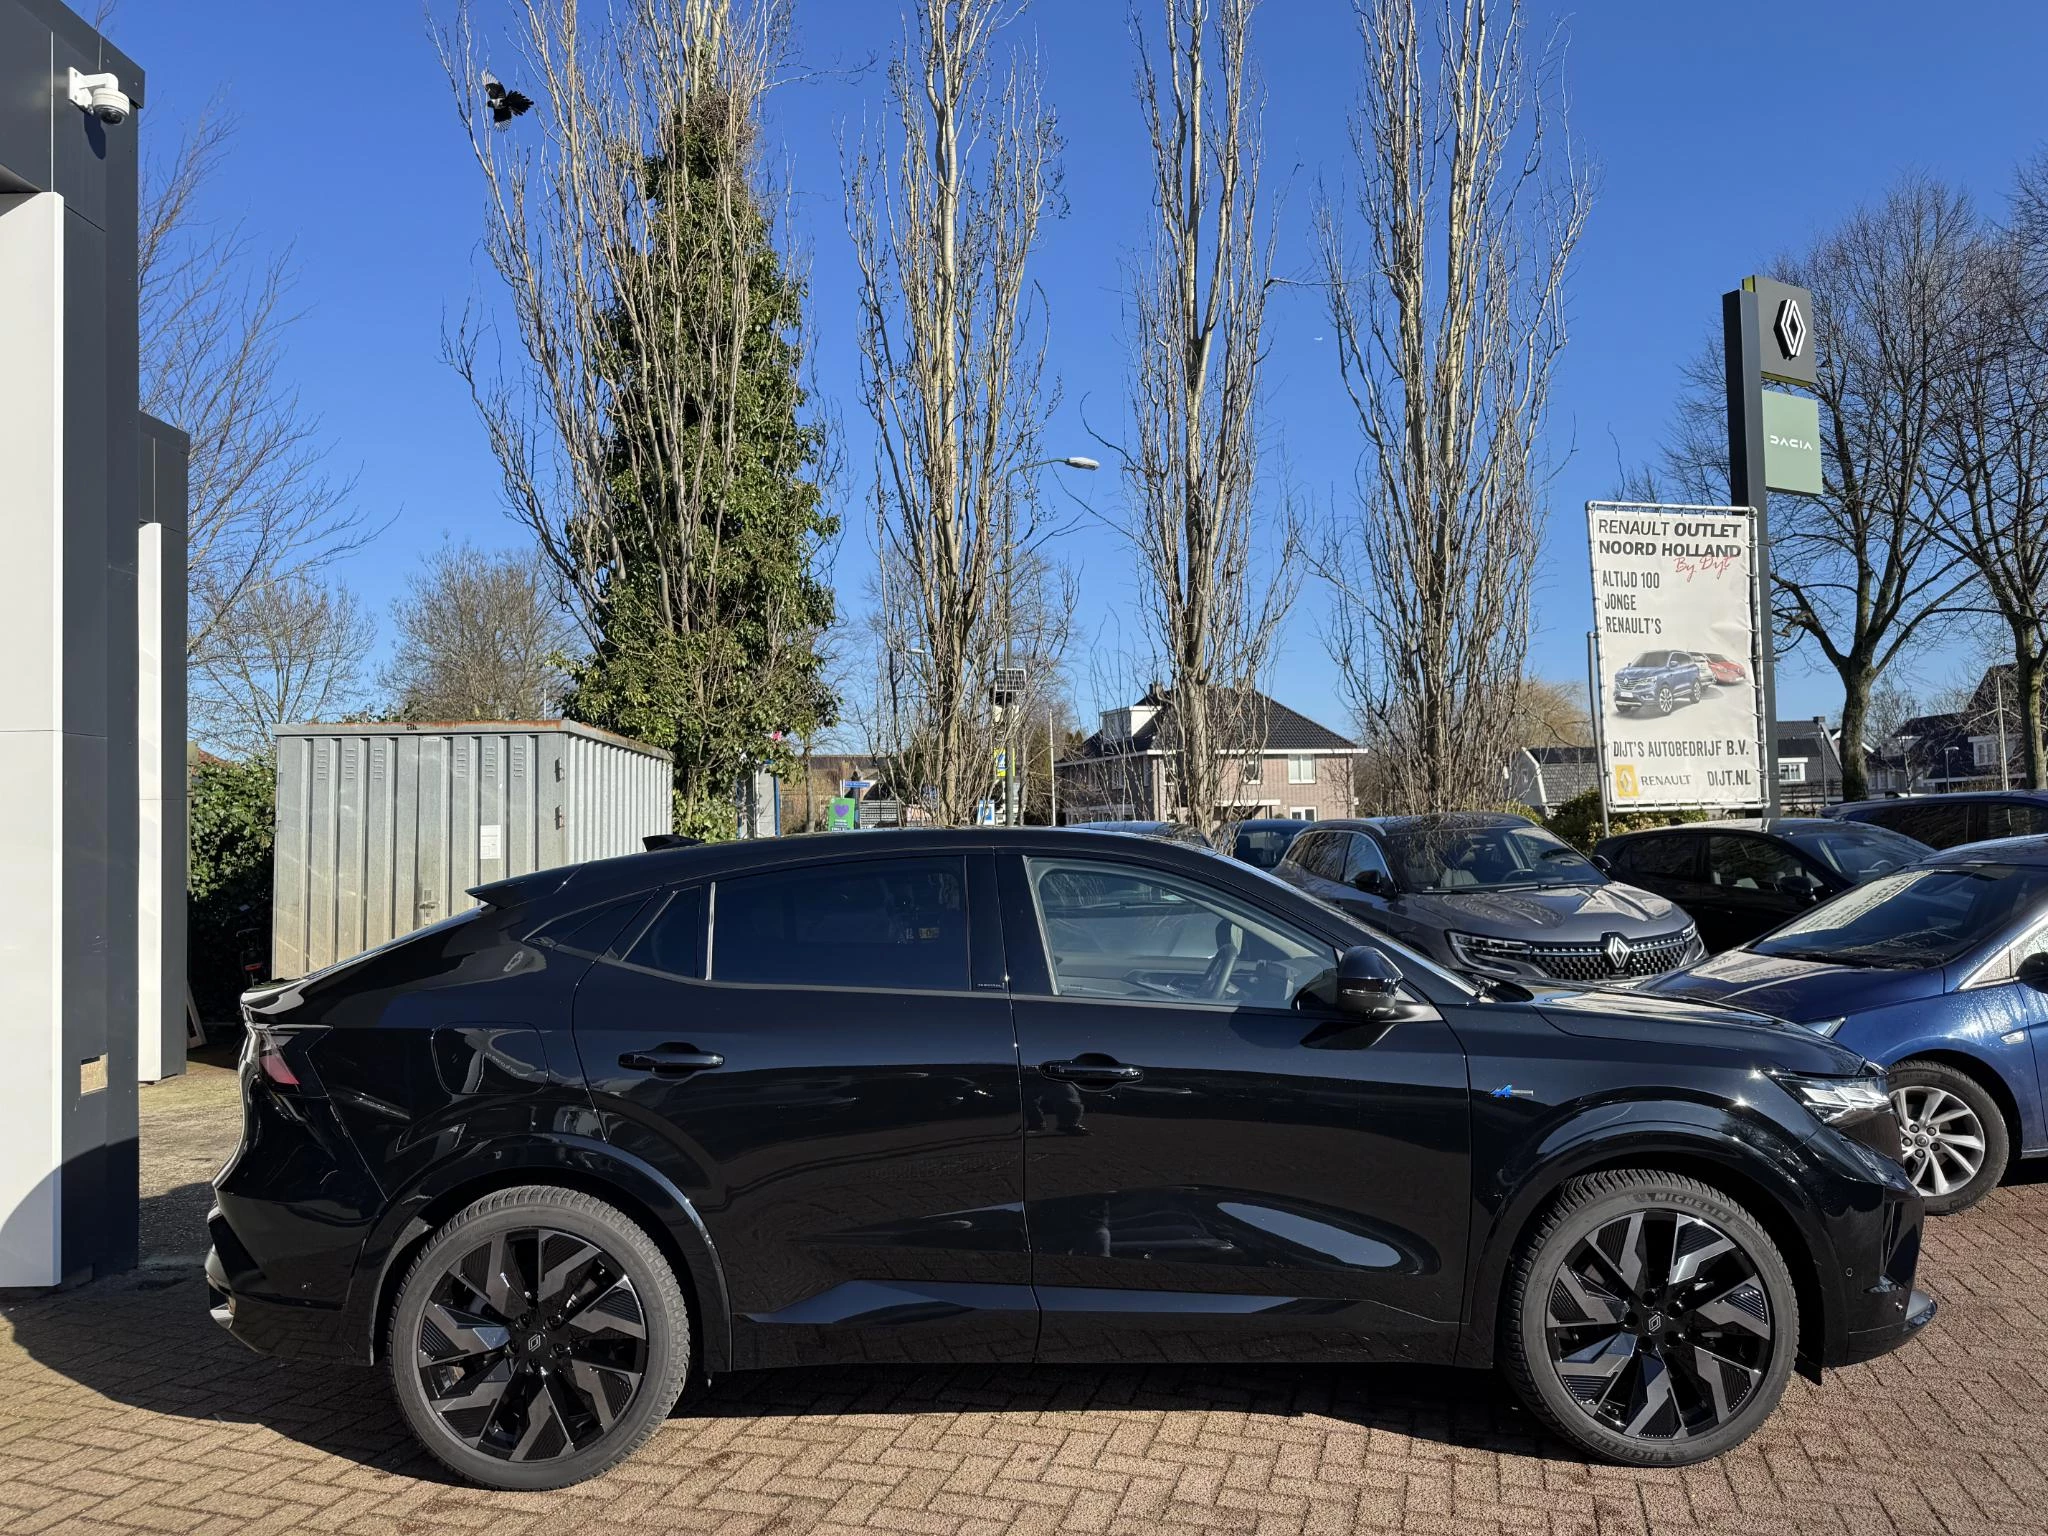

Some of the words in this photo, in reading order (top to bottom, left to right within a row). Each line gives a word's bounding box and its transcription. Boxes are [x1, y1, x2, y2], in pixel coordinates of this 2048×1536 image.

[1770, 434, 1812, 450] DACIA
[1599, 519, 1670, 536] RENAULT
[1674, 522, 1741, 538] OUTLET
[1599, 540, 1657, 556] NOORD
[1661, 542, 1741, 558] HOLLAND
[1674, 557, 1696, 583] By
[1602, 570, 1638, 588] ALTIJD
[1640, 571, 1660, 589] 100
[1604, 593, 1637, 611] JONGE
[1605, 616, 1662, 635] RENAULT'S
[1613, 740, 1645, 757] DIJT'S
[1648, 740, 1722, 757] AUTOBEDRIJF
[1726, 739, 1749, 756] B.V.
[1641, 775, 1692, 786] RENAULT
[1707, 769, 1752, 786] DIJT.NL
[1654, 1193, 1730, 1222] MICHELIN
